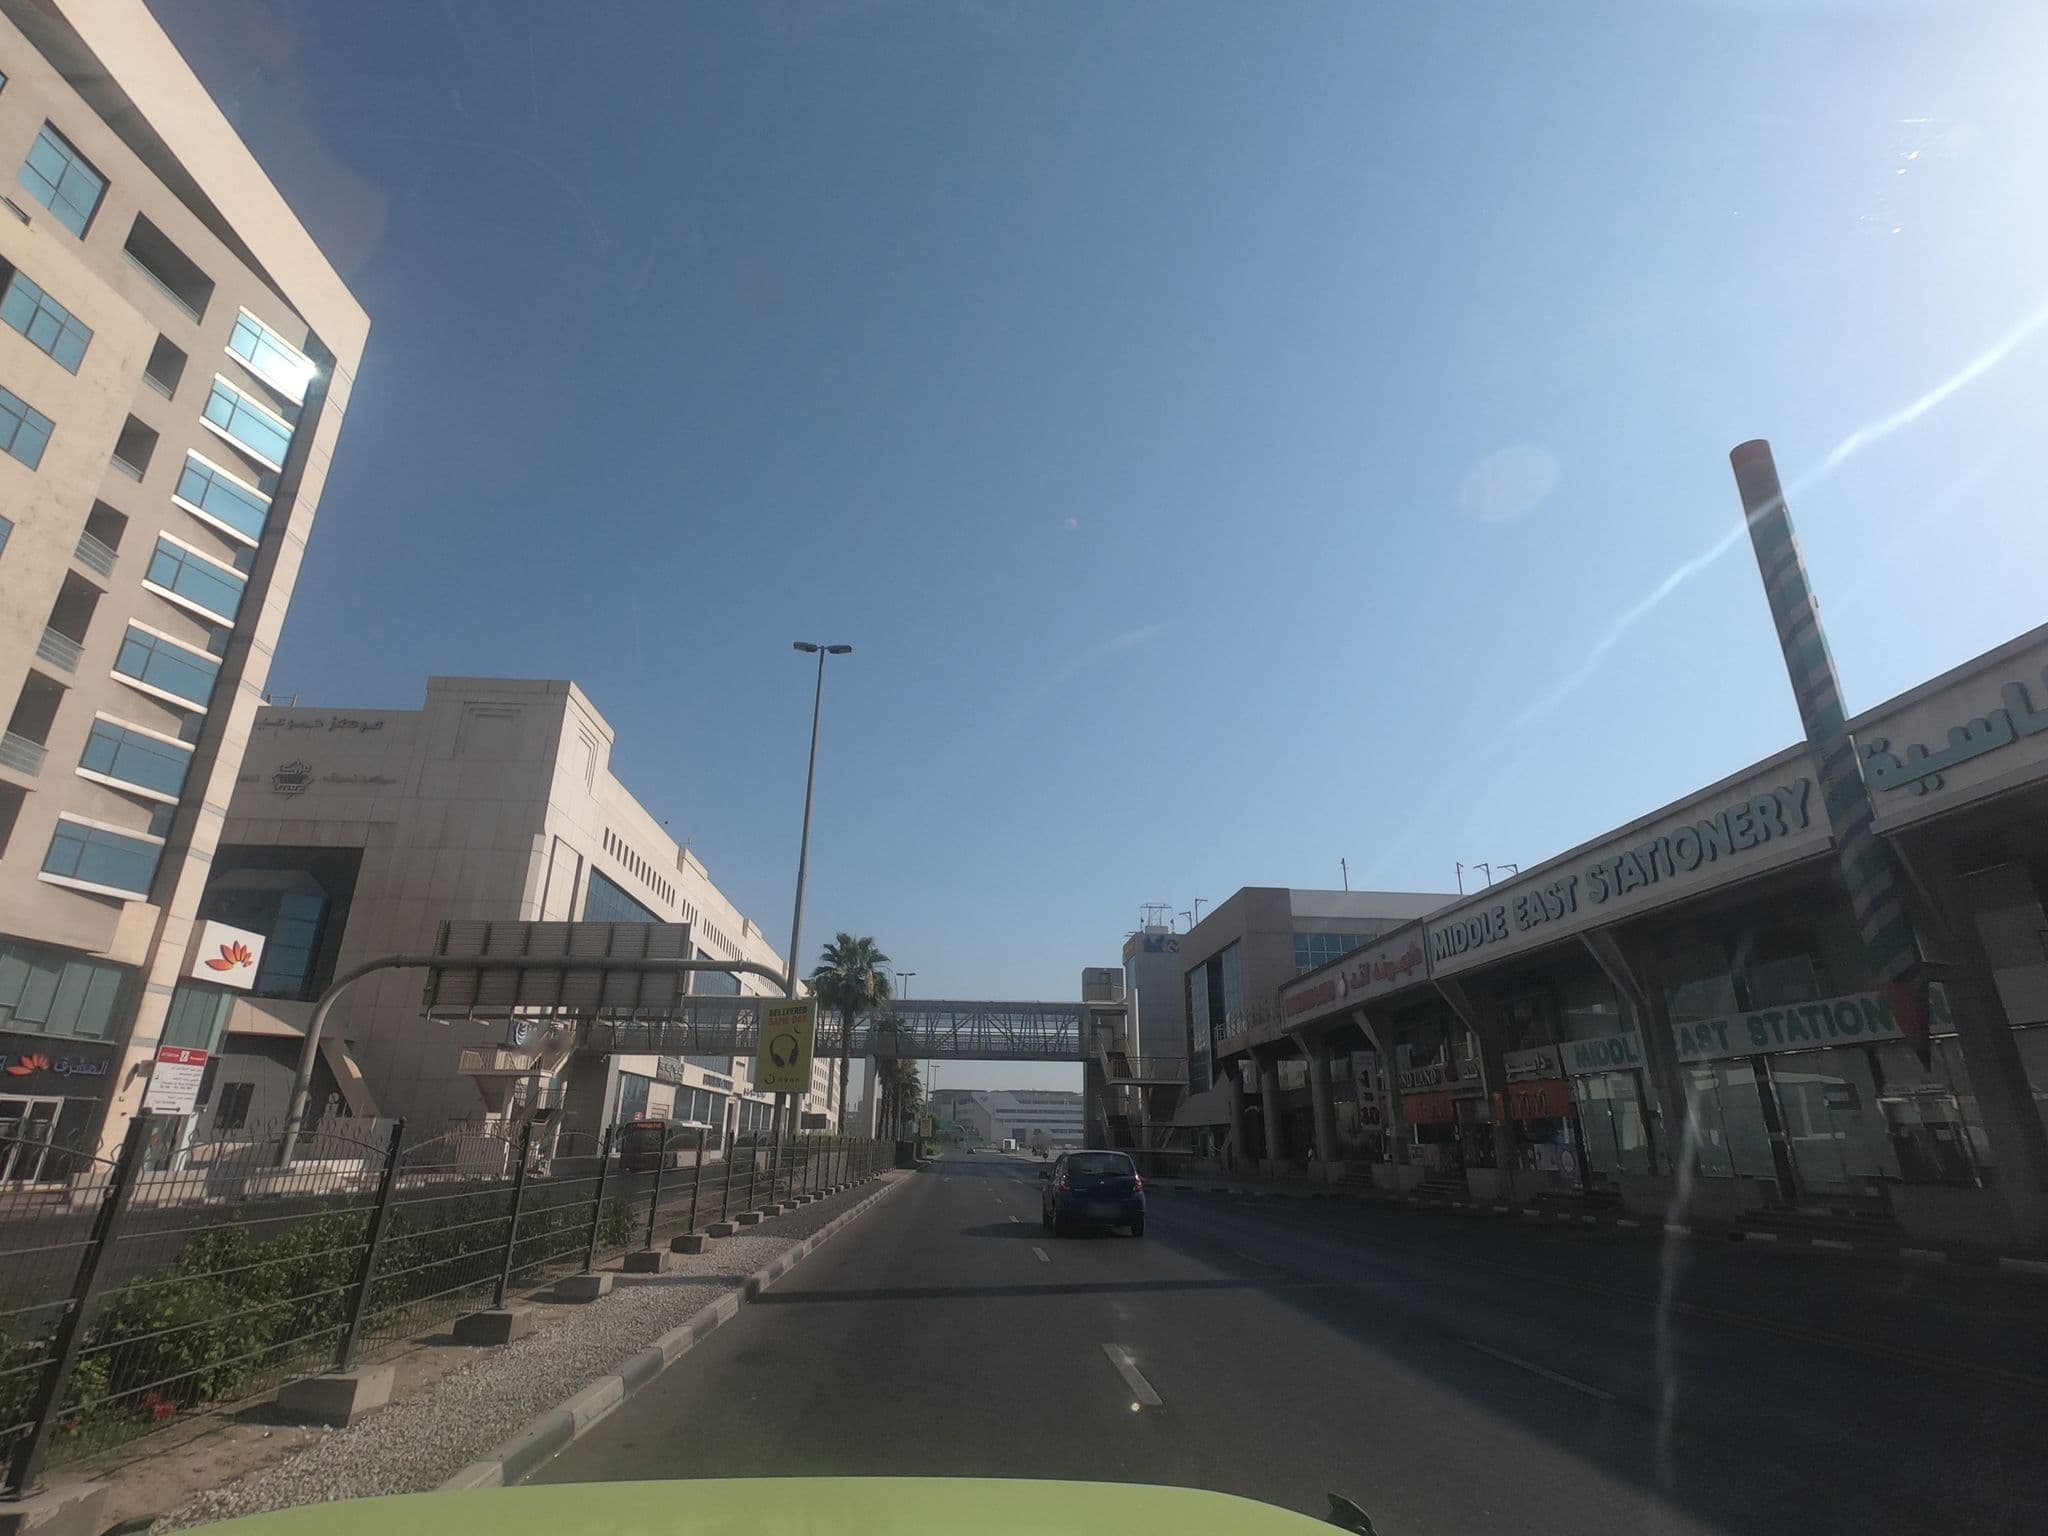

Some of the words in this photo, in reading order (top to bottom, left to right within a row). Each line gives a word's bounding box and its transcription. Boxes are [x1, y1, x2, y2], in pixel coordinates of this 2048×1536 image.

[1431, 906, 1508, 961] MIDDLE
[1513, 875, 1579, 931] EAST
[1588, 777, 1812, 904] STATIONERY
[1574, 1036, 1639, 1069] MIDDL
[1678, 1020, 1730, 1056] AST
